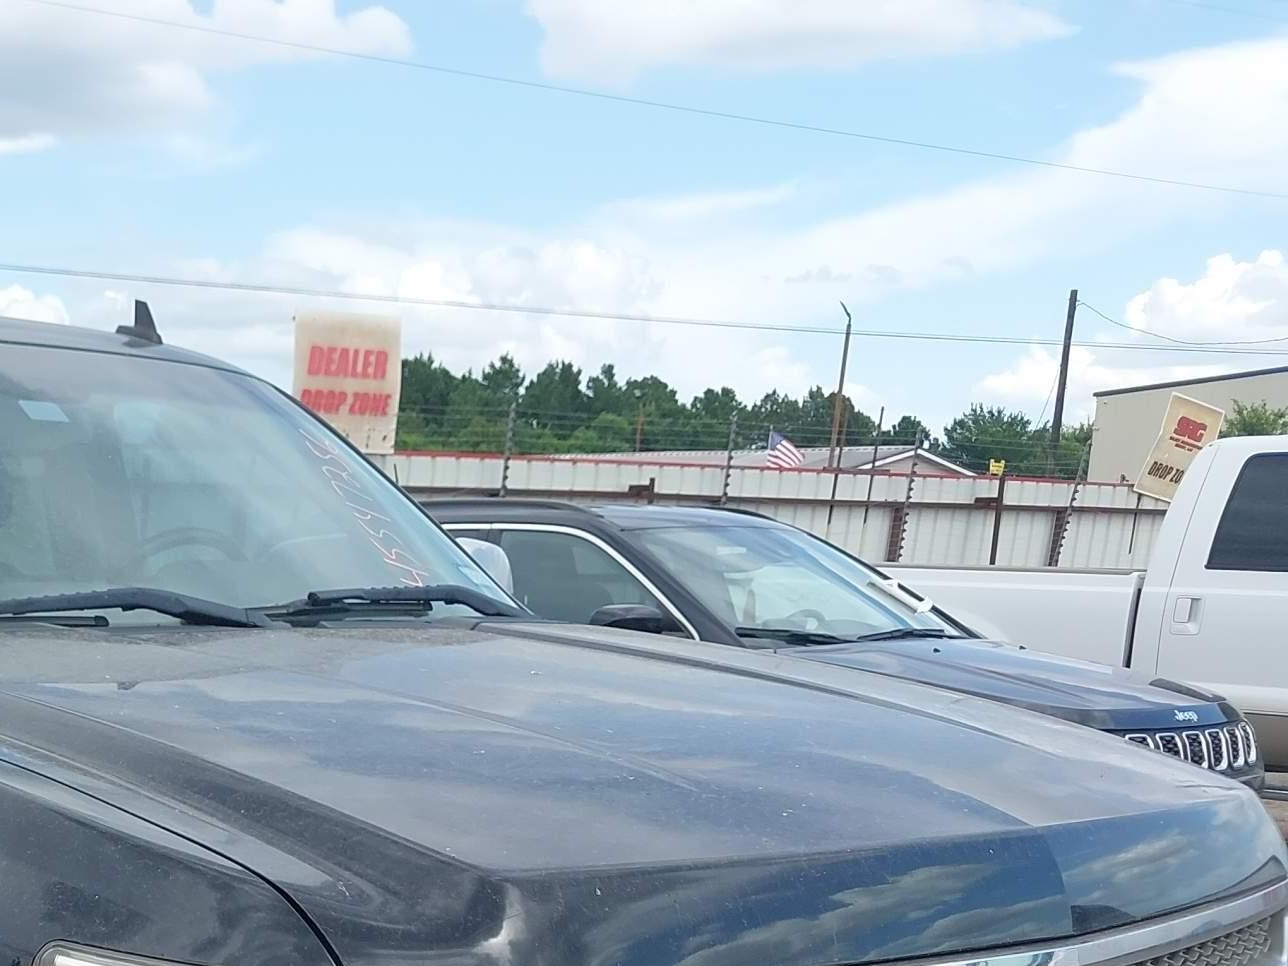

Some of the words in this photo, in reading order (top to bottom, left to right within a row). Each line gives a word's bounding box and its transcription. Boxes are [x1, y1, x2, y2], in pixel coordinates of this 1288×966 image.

[307, 345, 389, 380] DEALER
[300, 388, 347, 415] DROP
[349, 391, 392, 416] ZONE
[1147, 461, 1173, 481] DROP
[1173, 709, 1199, 723] Jeep
